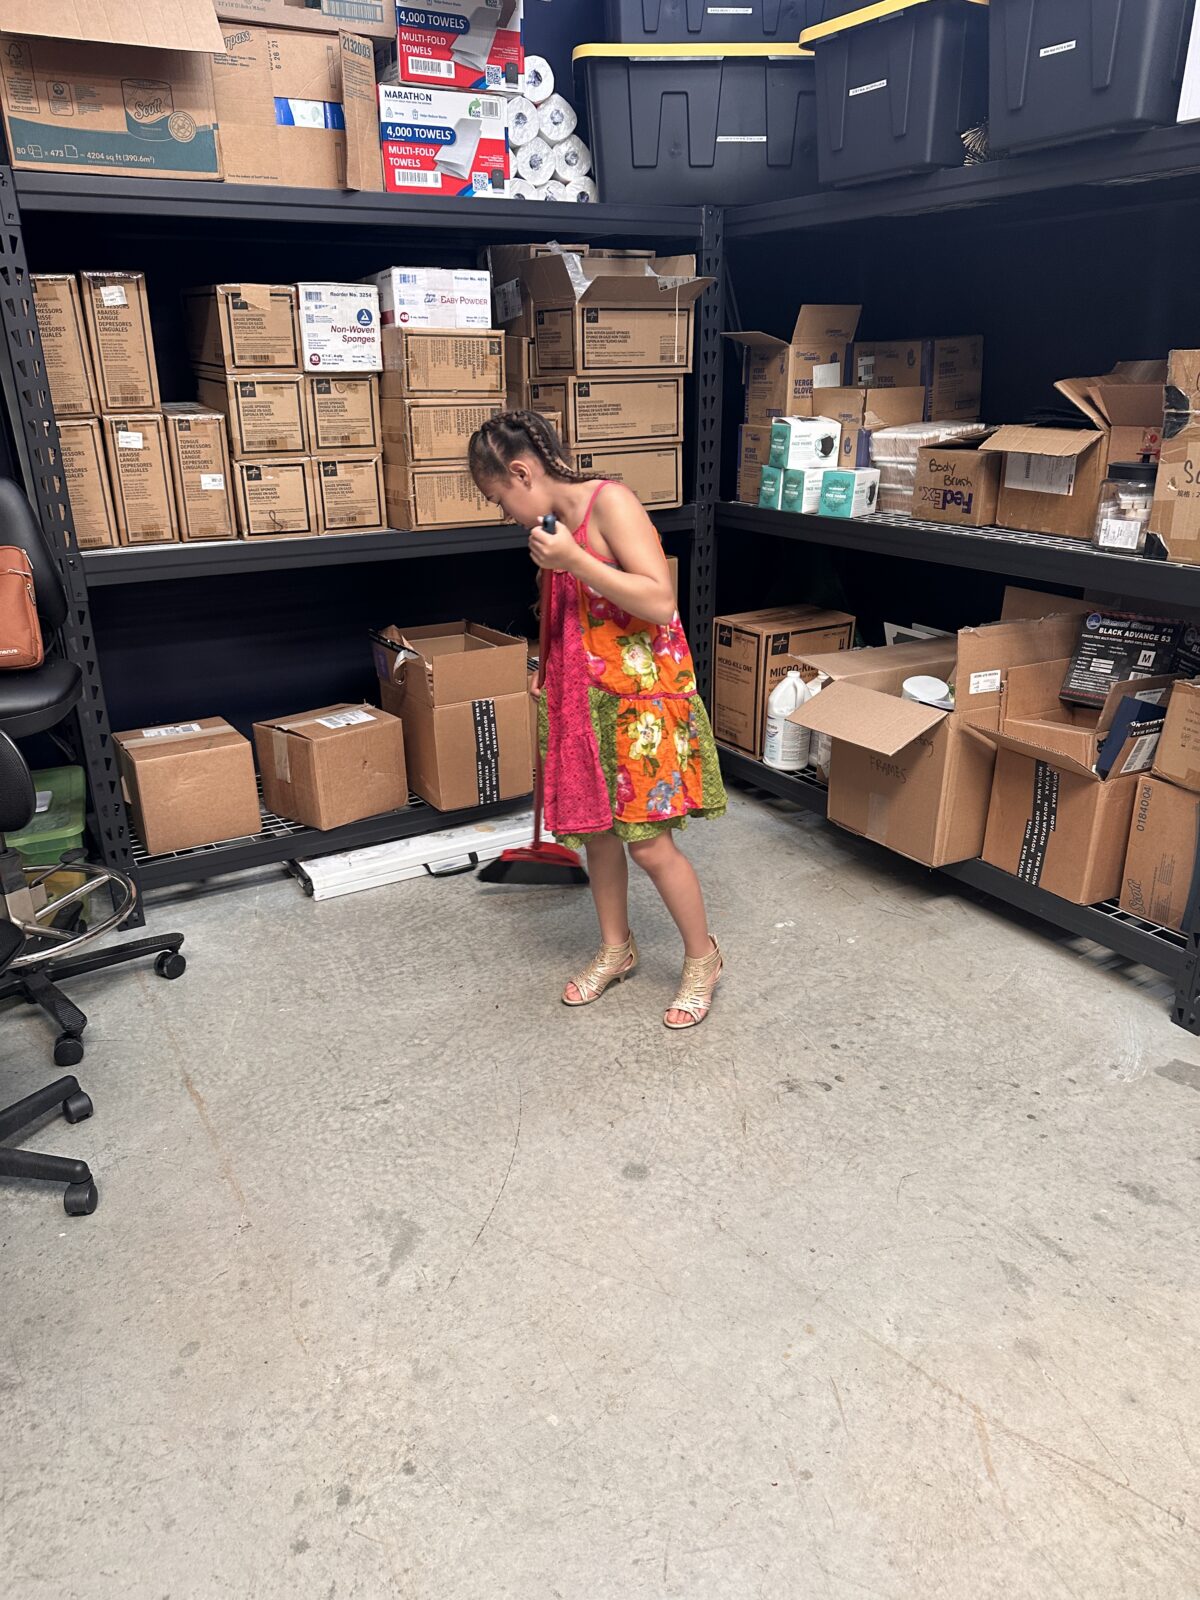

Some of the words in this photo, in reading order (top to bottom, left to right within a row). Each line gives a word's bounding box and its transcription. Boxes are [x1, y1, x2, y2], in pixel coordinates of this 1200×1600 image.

[400, 11, 425, 24] 4,000
[401, 32, 447, 46] MULTI-FOLD
[401, 44, 432, 56] TOWELS
[384, 90, 432, 102] MARATHON
[386, 126, 412, 138] 4,000
[16, 147, 26, 155] 80
[50, 149, 64, 157] 473
[86, 151, 105, 160] 4204
[106, 154, 115, 162] sq
[115, 153, 122, 161] ft
[388, 146, 435, 157] MULTI-FOLD
[389, 157, 421, 168] TOWELS
[330, 325, 375, 334] Non-Woven
[342, 335, 376, 344] Sponges
[929, 458, 957, 476] Body
[944, 475, 973, 487] Brush
[922, 487, 973, 515] FedEx
[1099, 628, 1123, 636] BLACK
[1124, 631, 1159, 641] ADVANCE
[1160, 635, 1171, 643] 53
[717, 657, 742, 670] MICRO-KILL
[743, 665, 752, 673] ONE
[1142, 654, 1151, 663] M
[870, 755, 907, 784] FRAMES
[1025, 821, 1033, 838] NOVA
[1127, 879, 1145, 915] Scott
